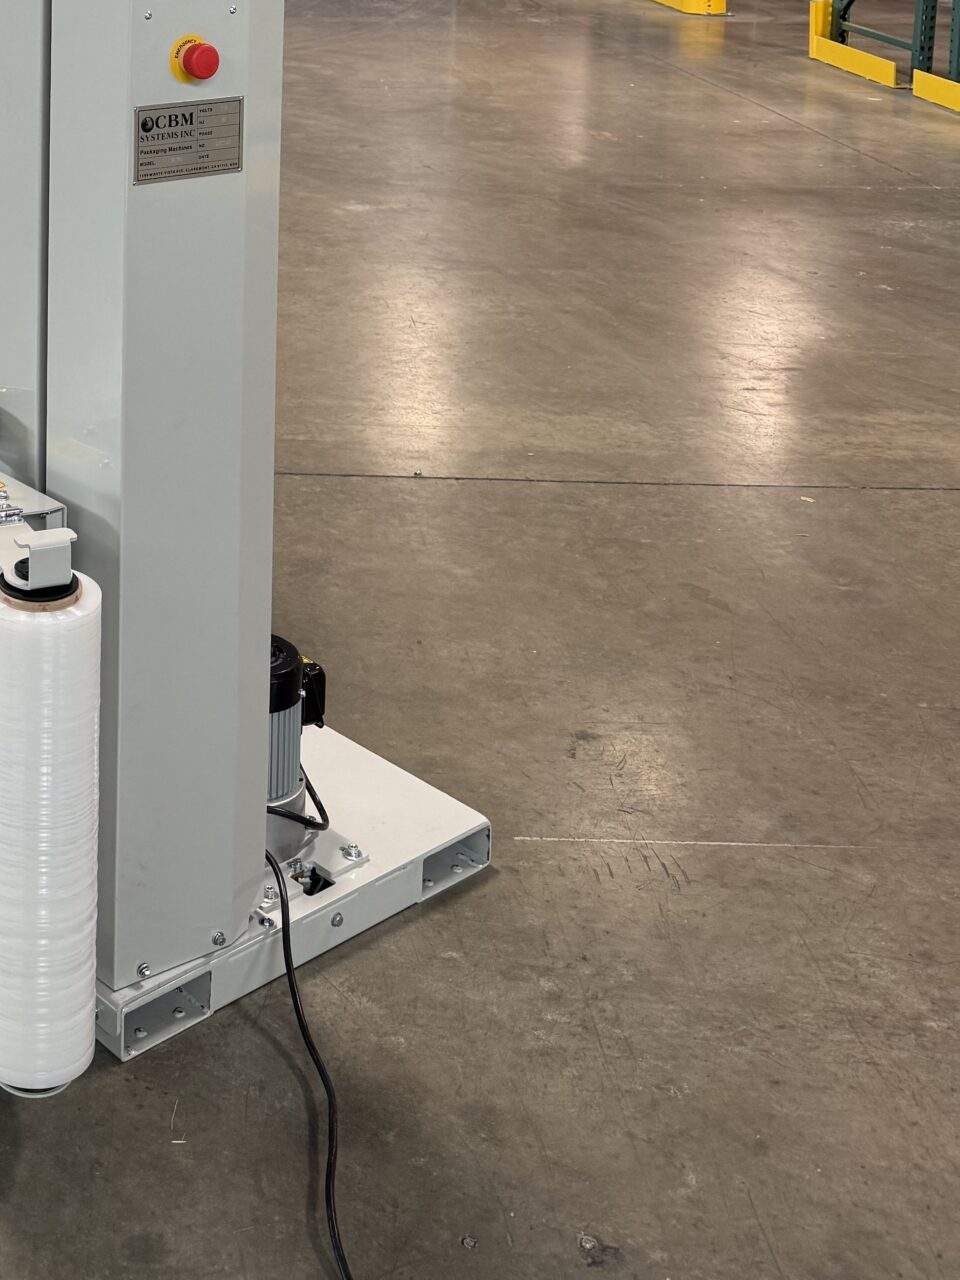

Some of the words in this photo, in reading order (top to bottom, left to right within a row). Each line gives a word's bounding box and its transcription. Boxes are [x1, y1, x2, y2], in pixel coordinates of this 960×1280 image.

[155, 112, 194, 129] CBM
[140, 131, 180, 143] SYSTEMS
[140, 147, 167, 156] Packaging
